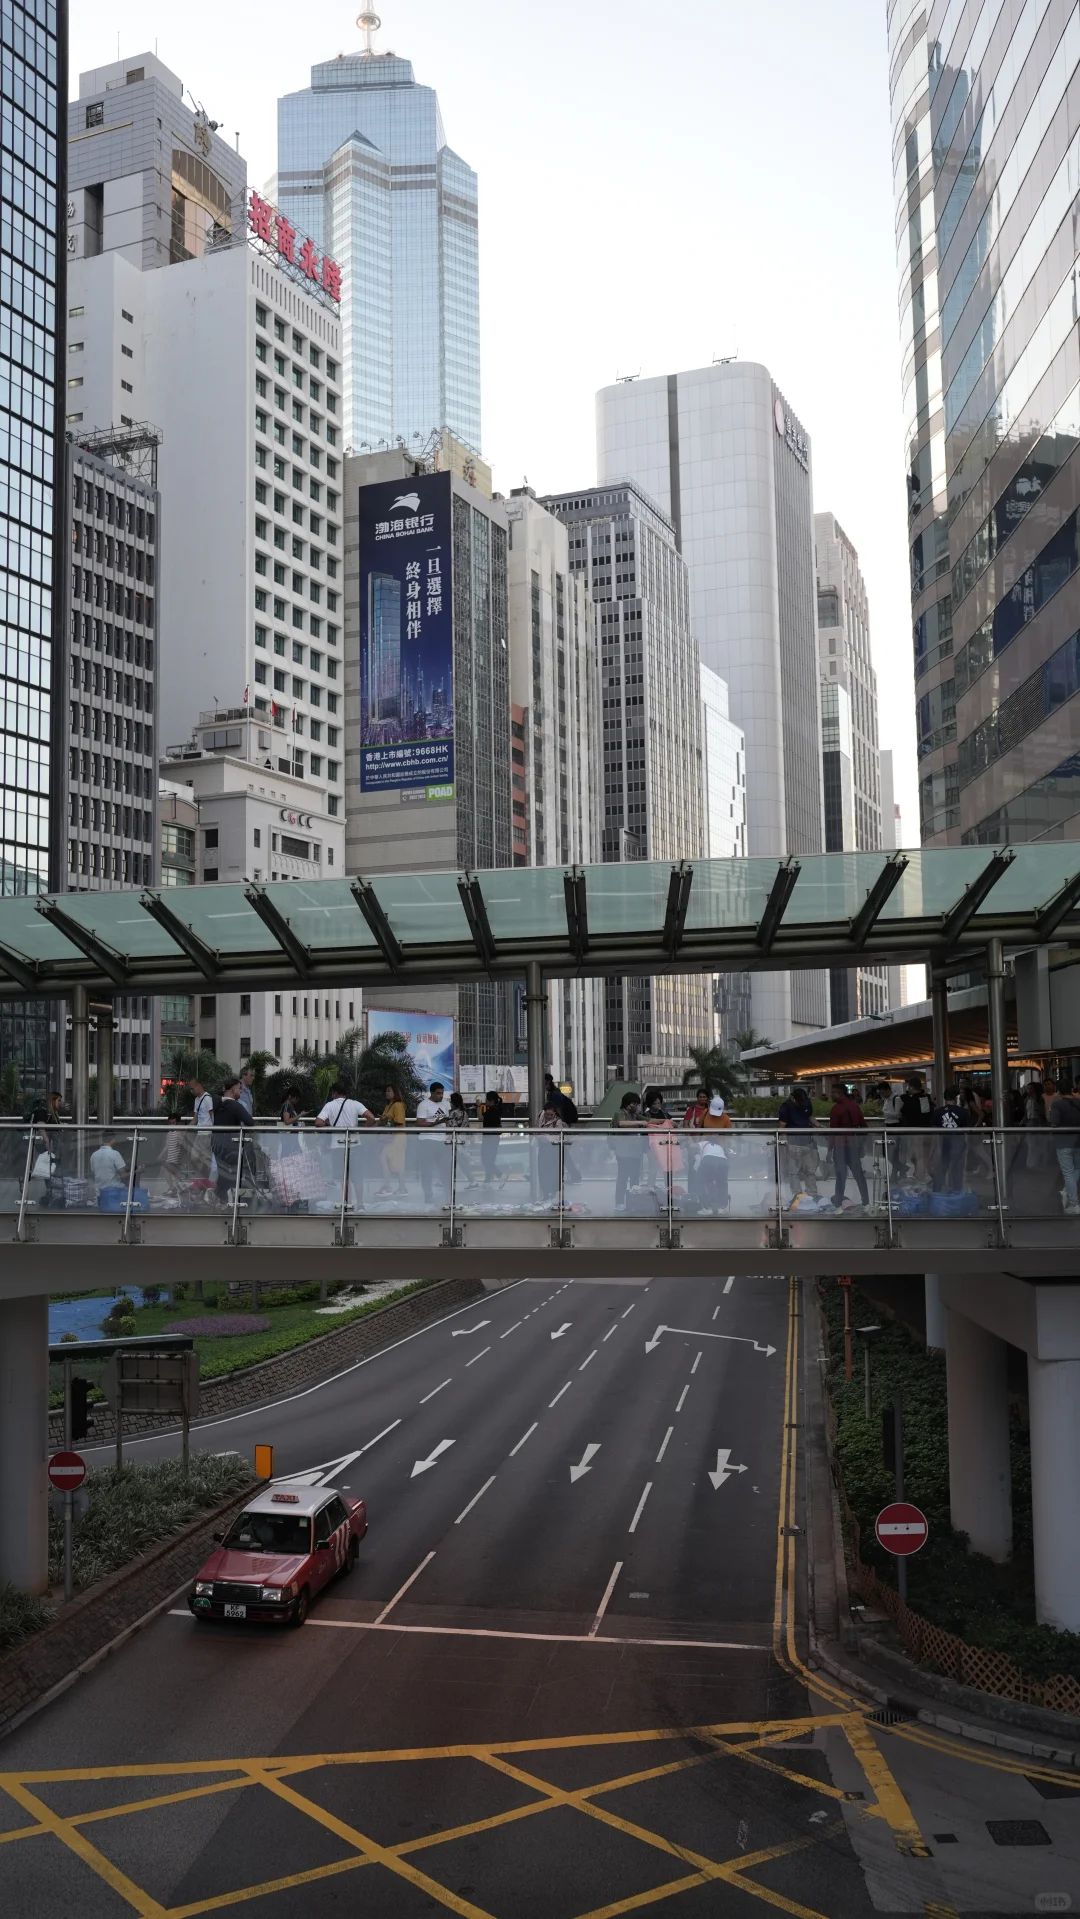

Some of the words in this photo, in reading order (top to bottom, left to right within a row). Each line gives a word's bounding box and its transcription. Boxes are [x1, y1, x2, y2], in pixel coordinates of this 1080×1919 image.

[248, 190, 342, 303] 招商永隆
[375, 513, 434, 535] 渤海银行
[375, 532, 395, 541] CHINA
[395, 529, 416, 538] BOHAI
[416, 526, 434, 535] BANK
[426, 545, 442, 616] 一旦選擇
[406, 561, 422, 640] 終身相伴
[365, 755, 449, 771] http://www.cbhb.com.cn/
[428, 786, 453, 799] POAD
[226, 1610, 245, 1619] 5962
